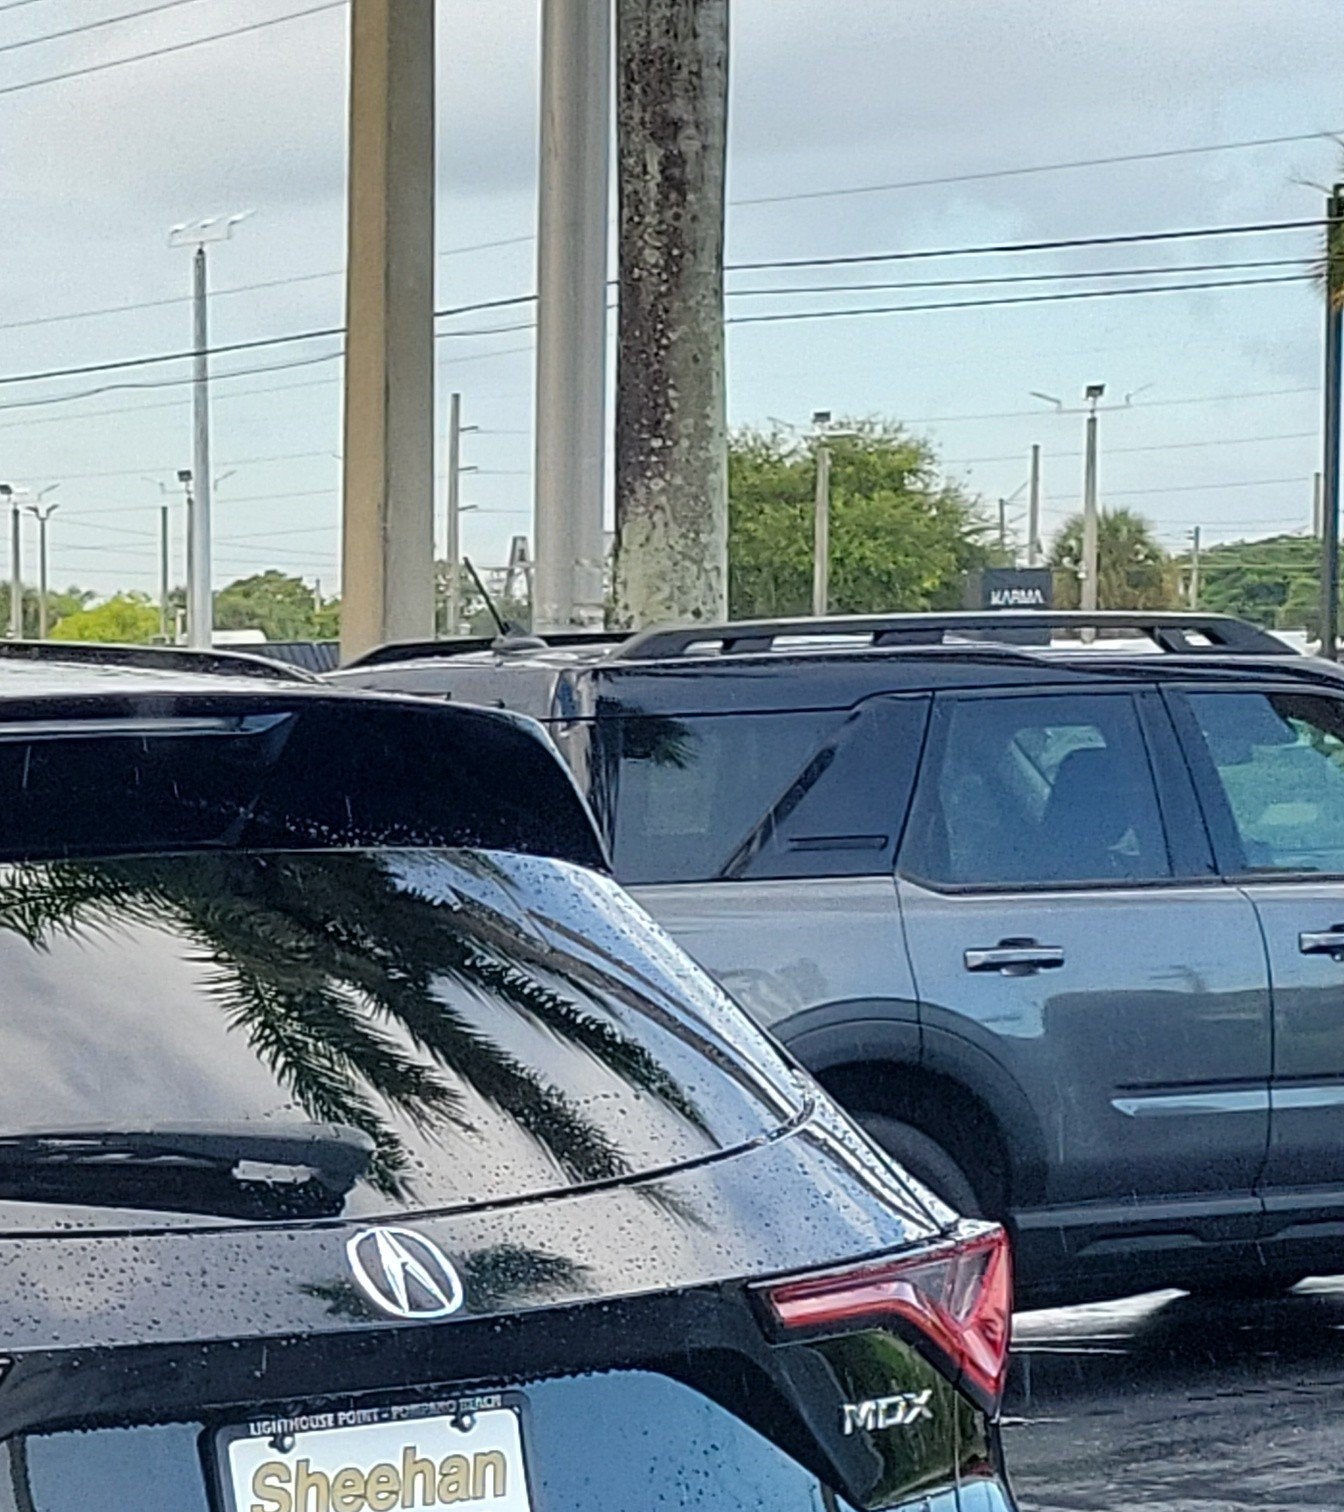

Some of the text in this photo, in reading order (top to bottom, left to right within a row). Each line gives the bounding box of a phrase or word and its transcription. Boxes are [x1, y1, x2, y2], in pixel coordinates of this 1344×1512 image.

[991, 588, 1045, 606] KARMA
[249, 1412, 335, 1436] LIGHTHOUSE
[337, 1408, 380, 1426] POINT
[843, 1388, 934, 1436] MDX
